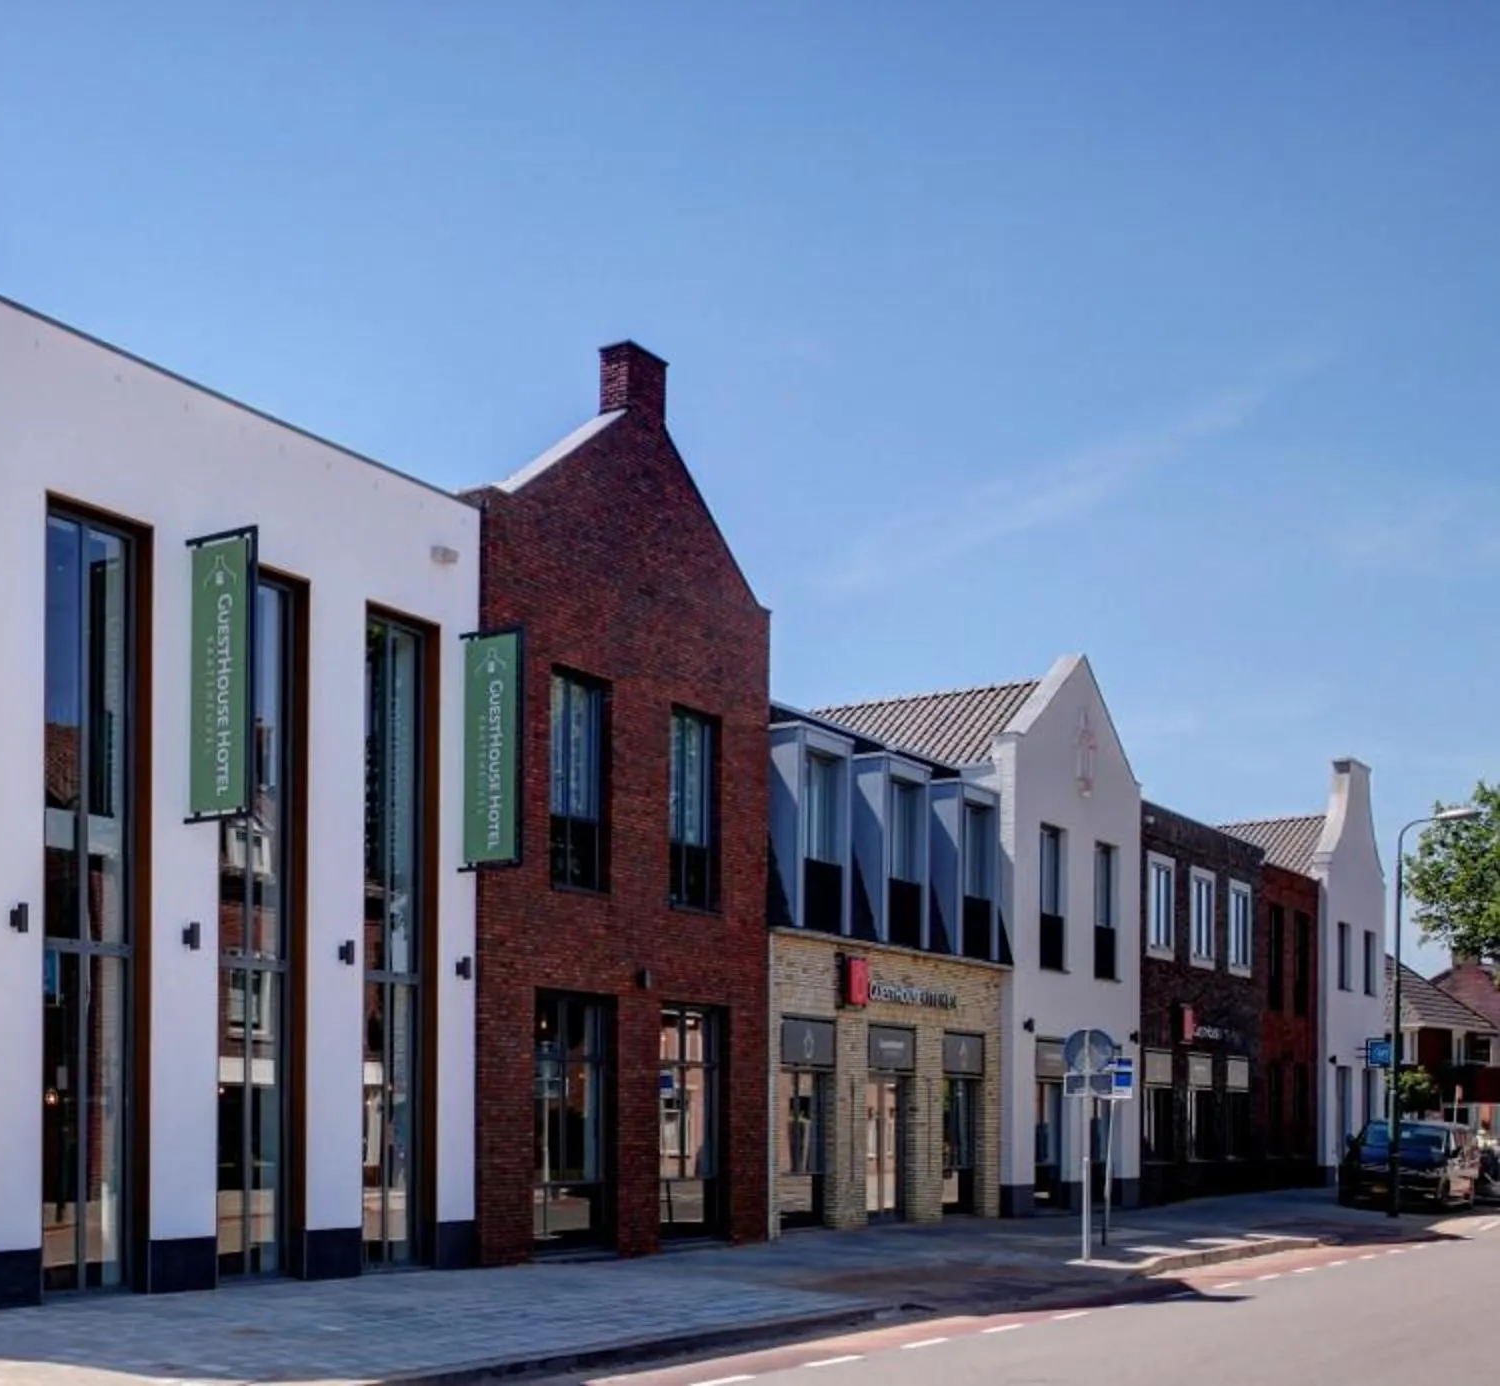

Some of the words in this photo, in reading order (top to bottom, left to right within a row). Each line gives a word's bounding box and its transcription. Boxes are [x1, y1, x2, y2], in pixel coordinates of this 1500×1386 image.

[217, 593, 233, 726] GUESTHOUSE
[216, 731, 232, 797] HOTEL
[488, 679, 504, 792] GUESTHOUSE
[487, 794, 503, 850] HOTEL
